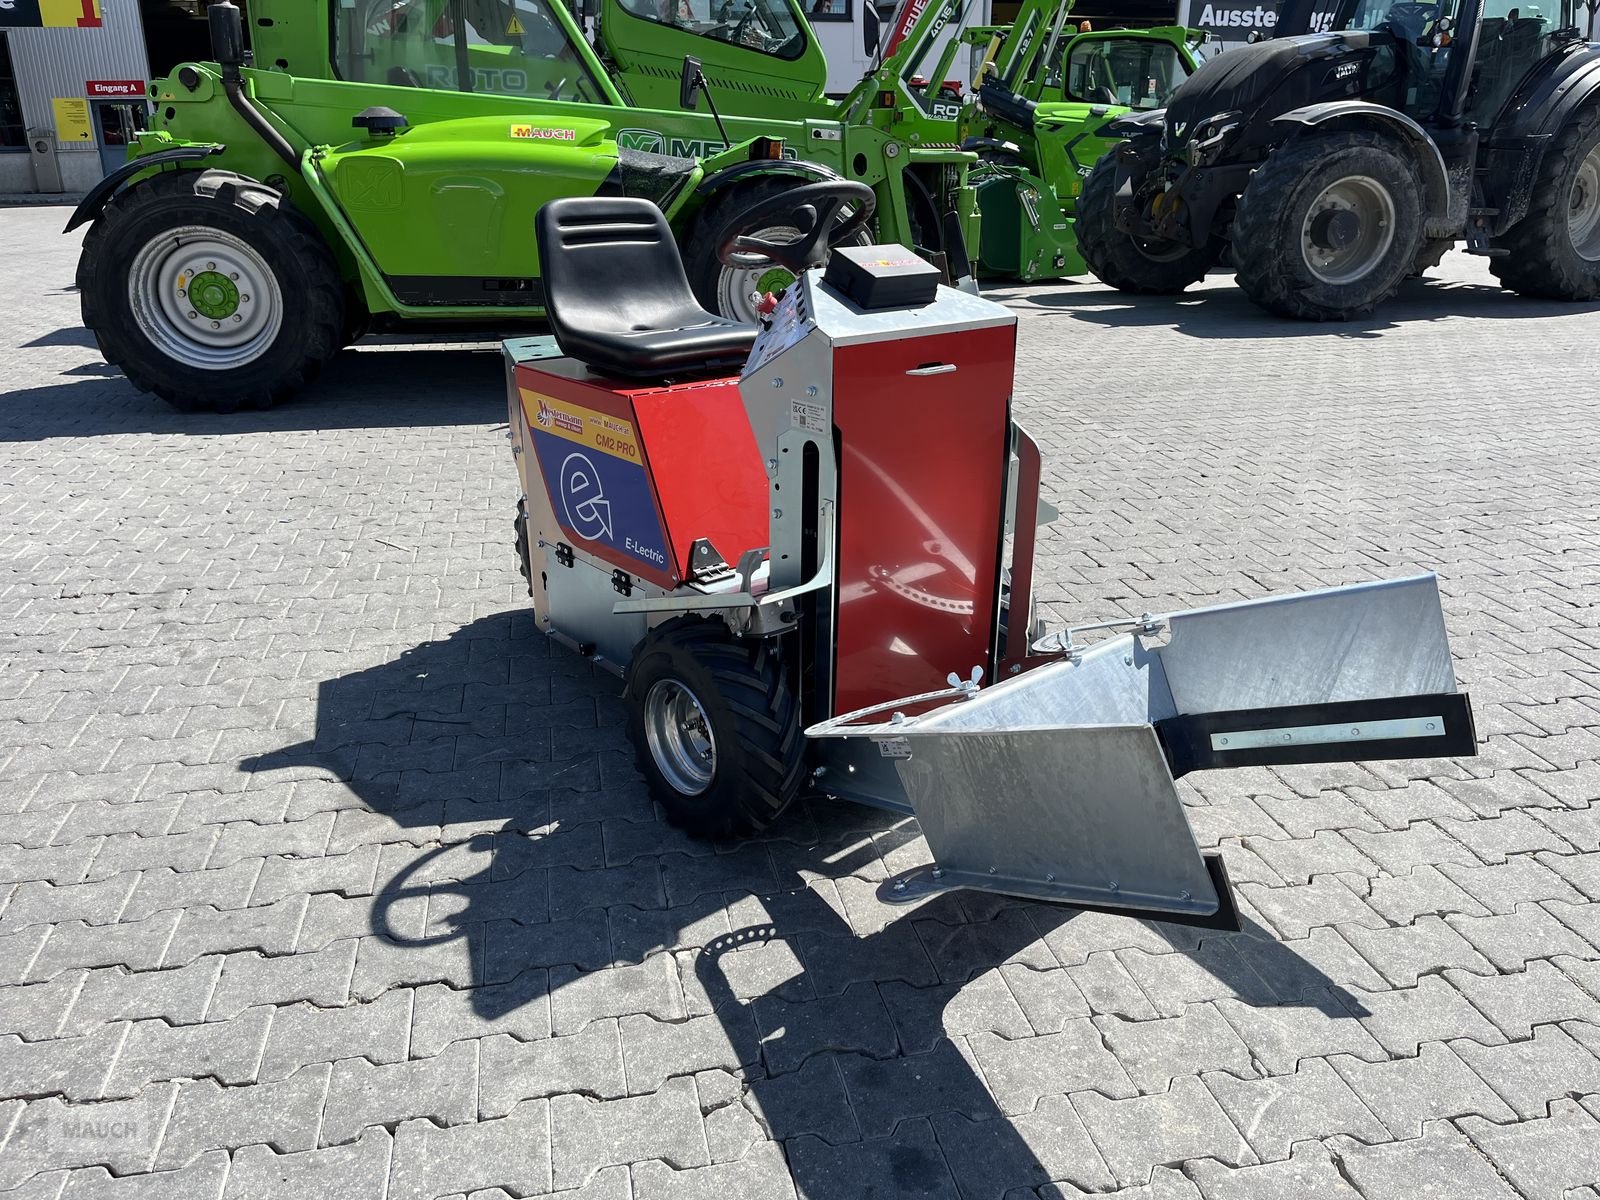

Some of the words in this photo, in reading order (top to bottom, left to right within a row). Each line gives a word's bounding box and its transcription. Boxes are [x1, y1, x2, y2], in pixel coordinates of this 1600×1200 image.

[931, 6, 952, 38] 40.16
[1020, 29, 1033, 55] 42.7
[95, 84, 128, 93] Eingang
[934, 104, 962, 116] RO
[515, 127, 574, 140] MAUCH
[596, 434, 614, 450] CM2
[616, 441, 636, 457] PRO
[625, 537, 664, 564] E-Lectric
